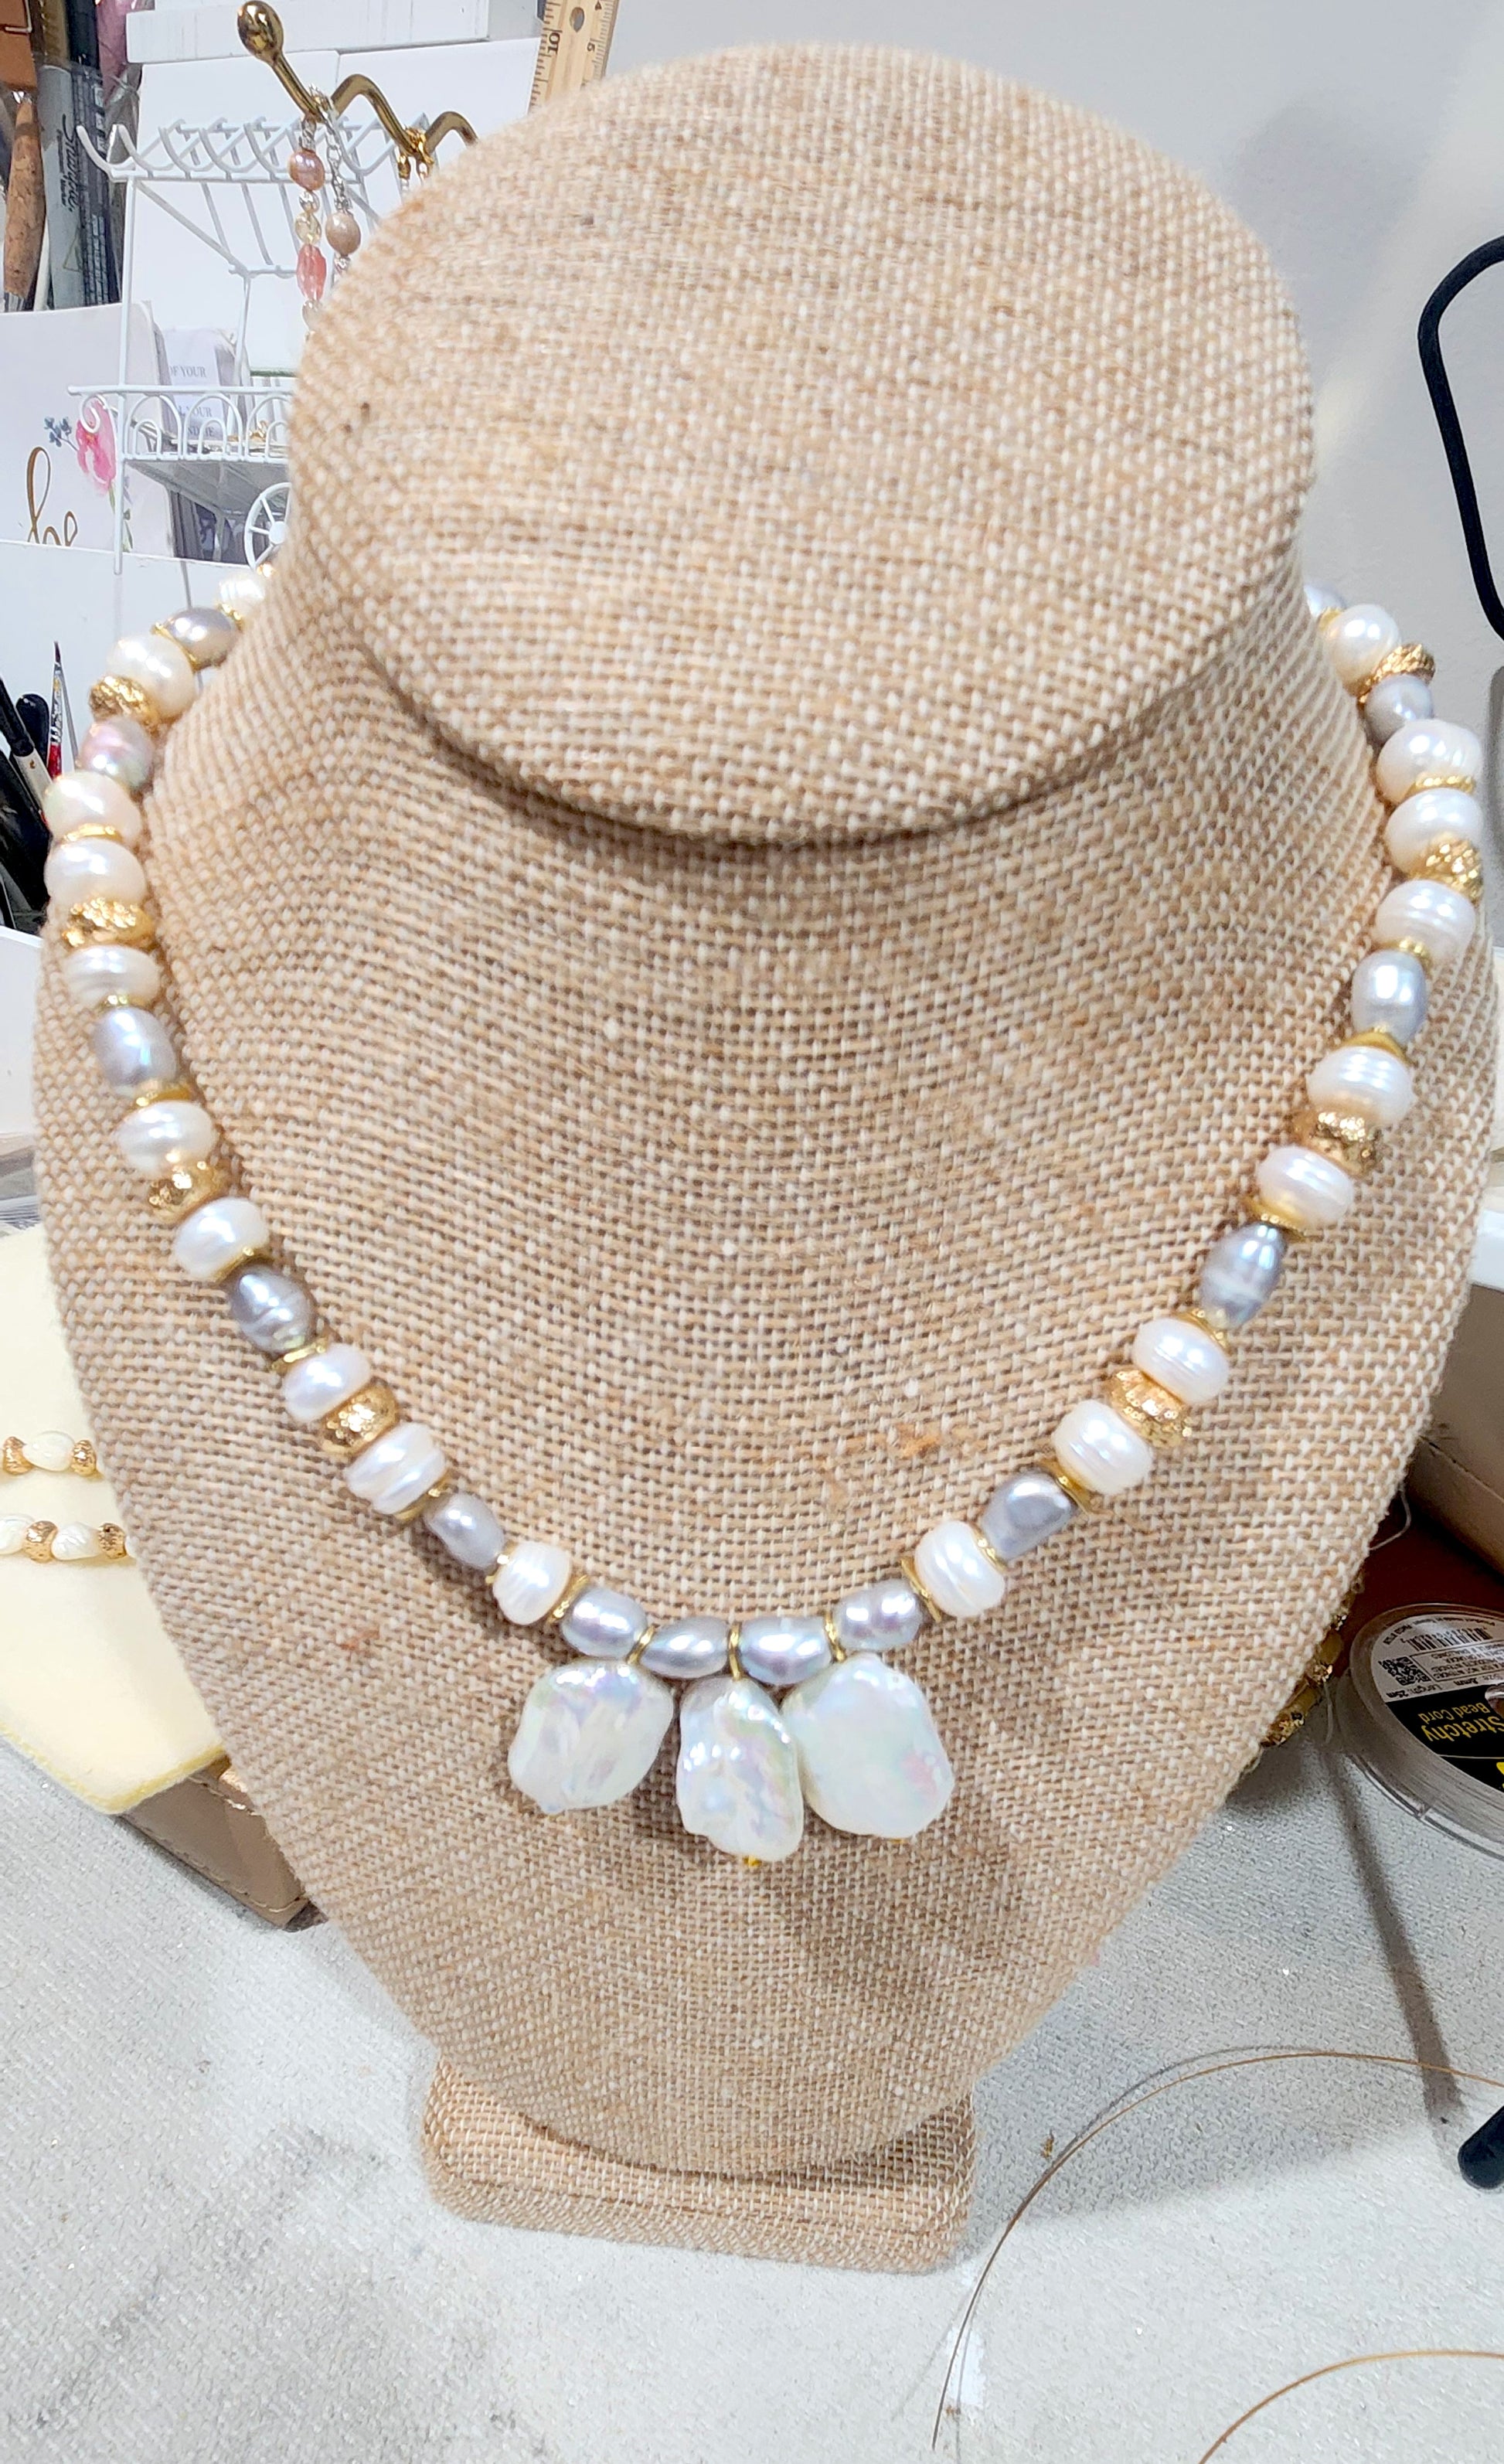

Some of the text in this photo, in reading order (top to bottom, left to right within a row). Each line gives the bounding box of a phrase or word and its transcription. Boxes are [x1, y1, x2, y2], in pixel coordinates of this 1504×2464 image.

[547, 32, 560, 54] 10
[180, 366, 206, 378] YOUR
[1418, 1703, 1490, 1724] Bead Cord
[1421, 1716, 1504, 1742] Stretchy
